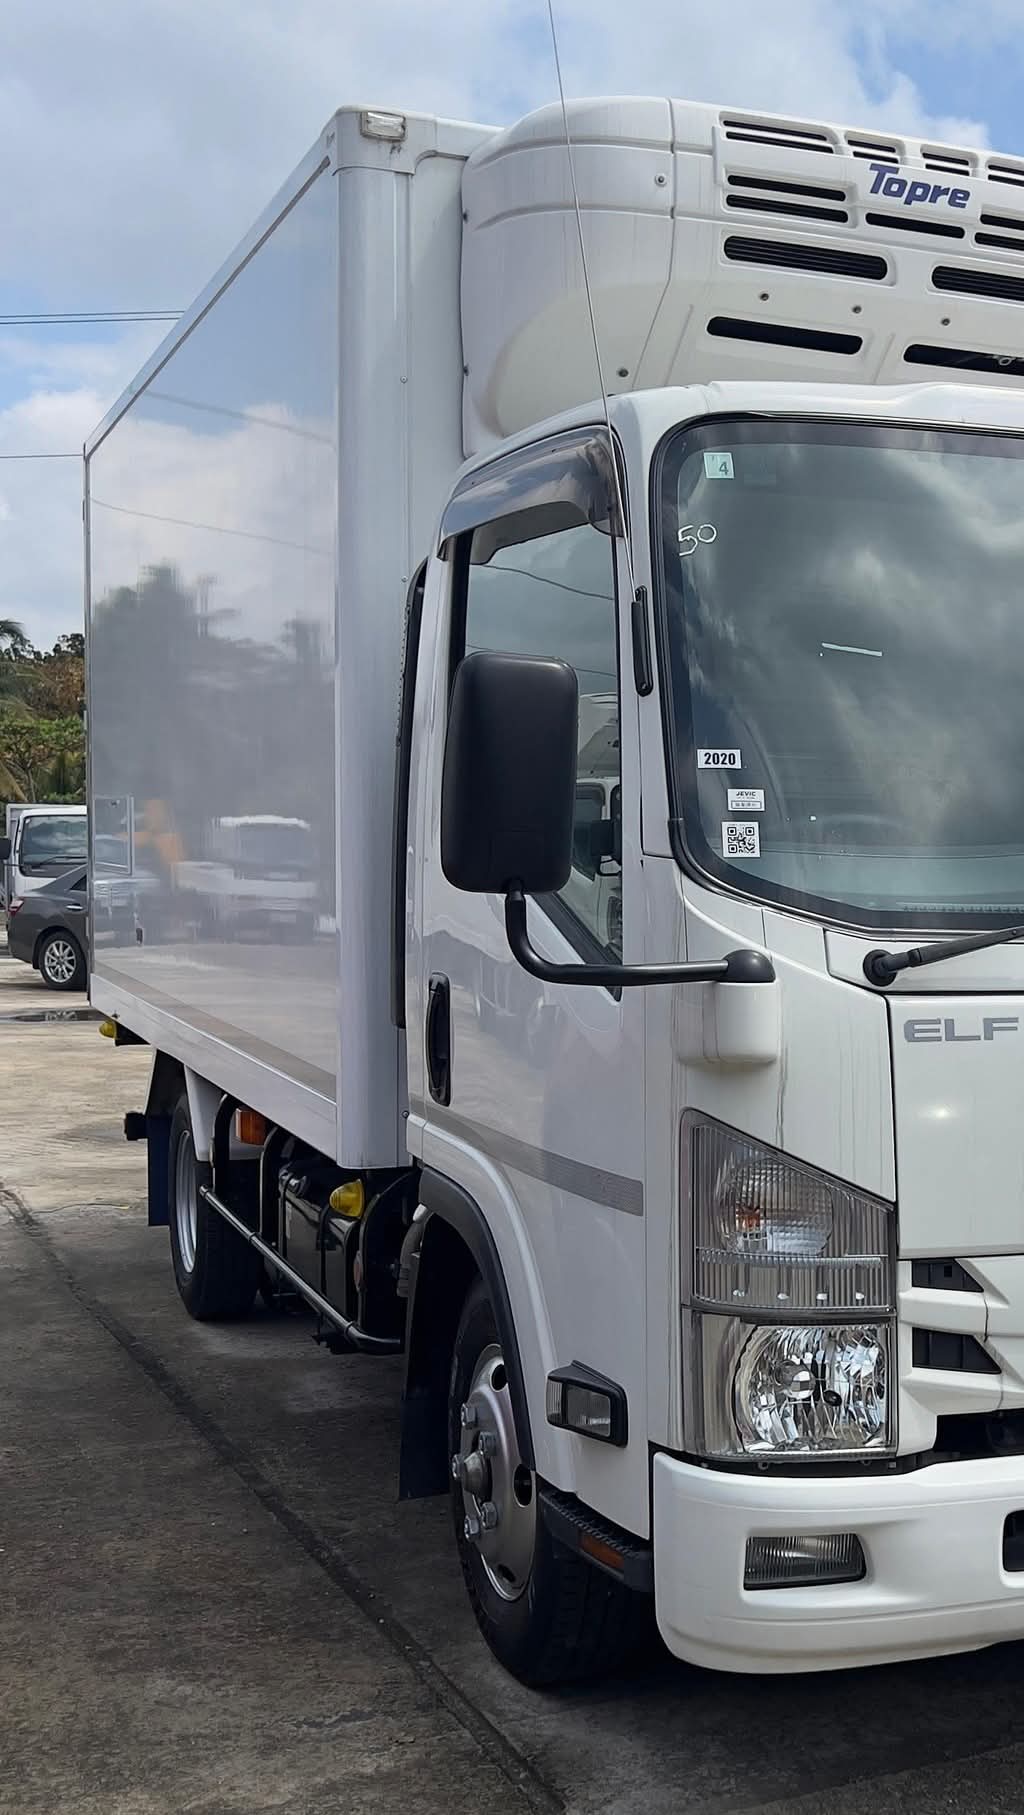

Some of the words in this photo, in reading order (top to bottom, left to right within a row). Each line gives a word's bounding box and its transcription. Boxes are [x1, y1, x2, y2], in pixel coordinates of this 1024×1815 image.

[869, 163, 970, 209] Topre
[719, 461, 729, 476] 4
[678, 524, 717, 556] 50
[703, 752, 736, 766] 2020
[903, 1017, 1020, 1042] ELF
